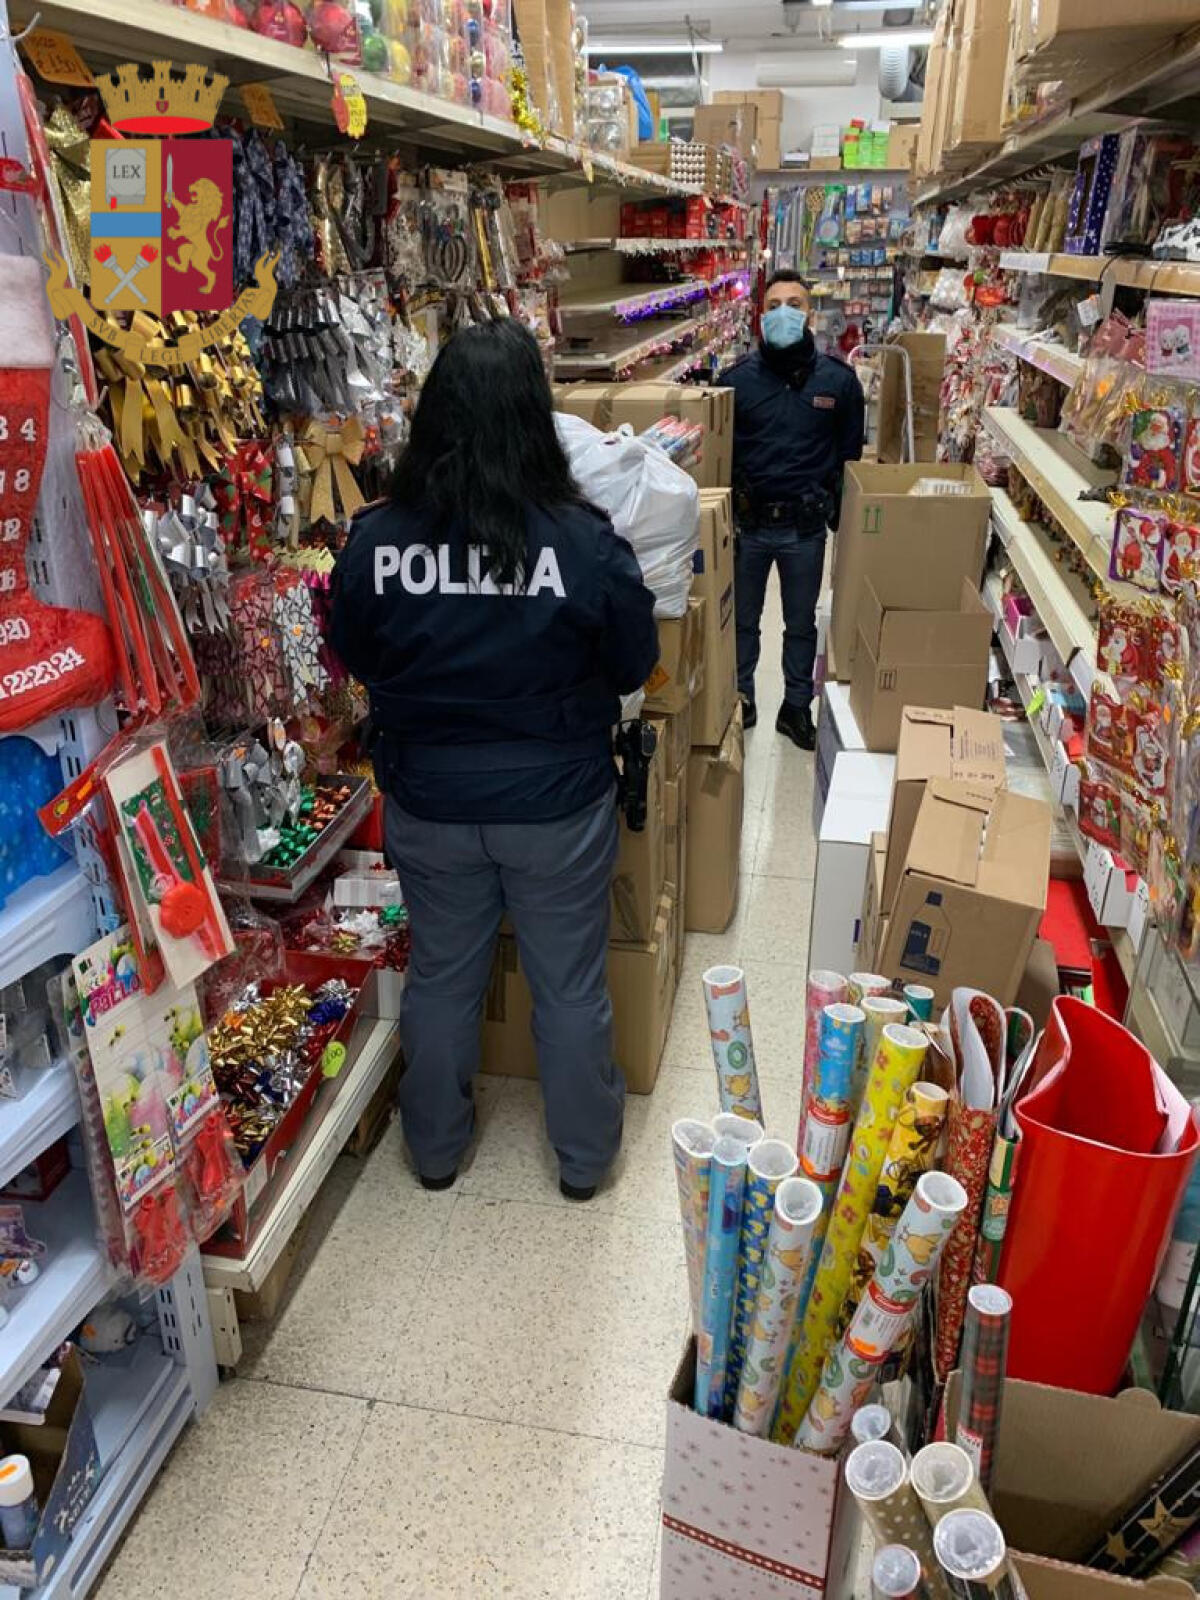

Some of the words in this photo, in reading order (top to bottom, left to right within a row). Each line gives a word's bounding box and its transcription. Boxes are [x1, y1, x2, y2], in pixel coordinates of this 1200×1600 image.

[20, 418, 37, 441] 4
[14, 469, 30, 491] 8
[4, 617, 30, 640] 20
[3, 671, 35, 696] 22
[50, 646, 86, 674] 24
